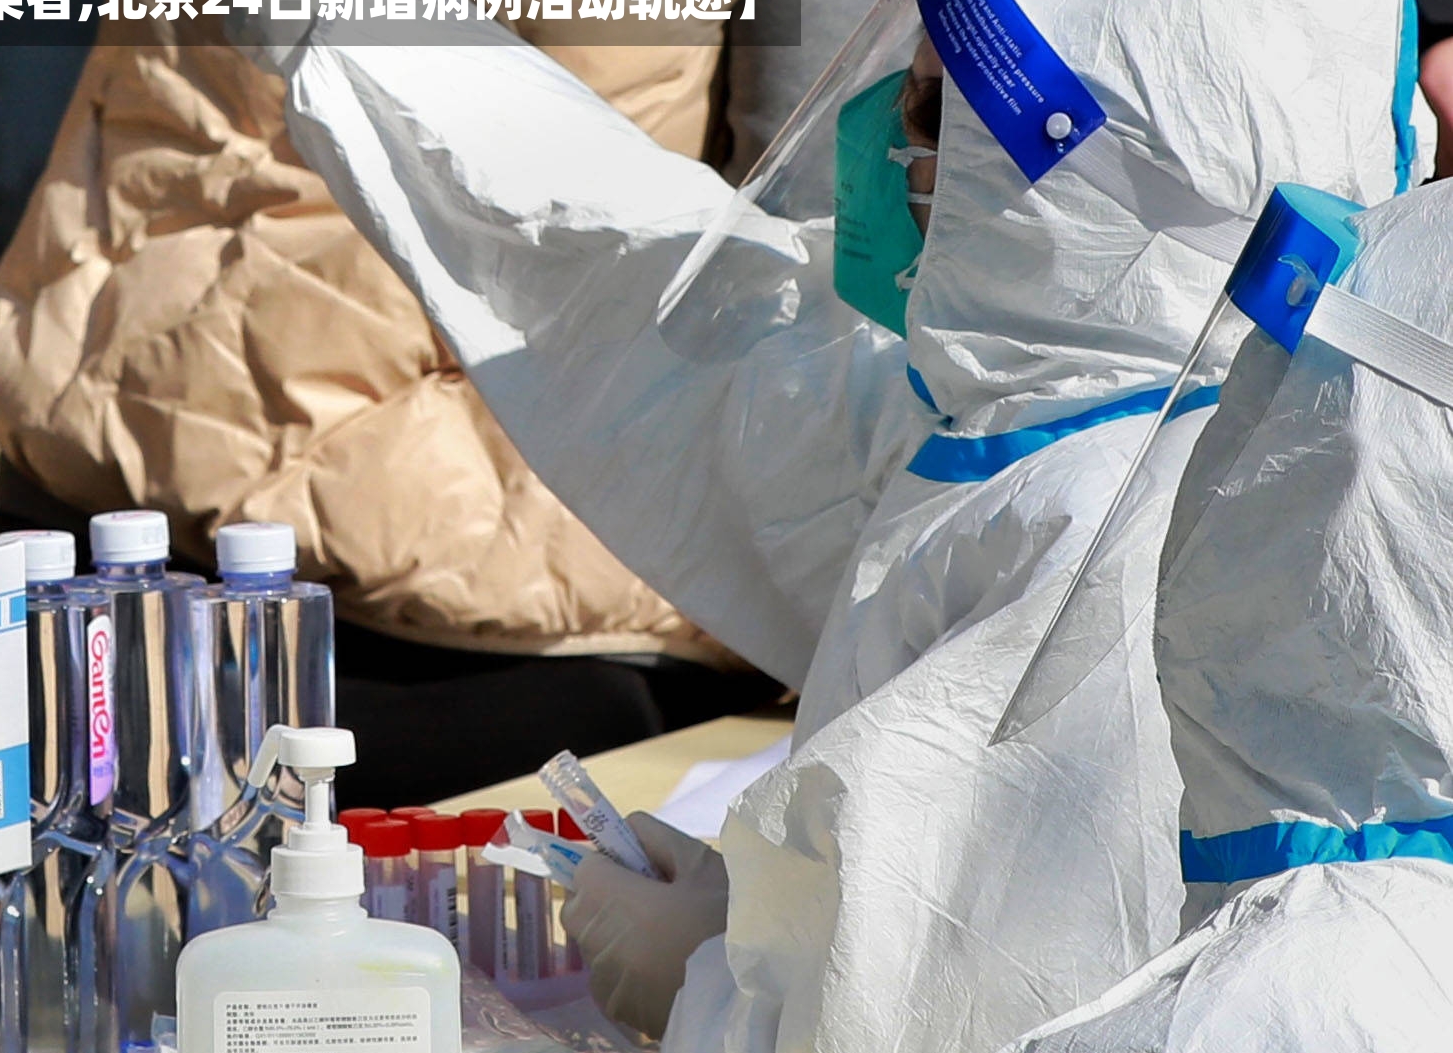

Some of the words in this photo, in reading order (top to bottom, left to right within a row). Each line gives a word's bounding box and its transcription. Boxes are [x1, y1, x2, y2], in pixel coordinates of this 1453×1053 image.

[992, 18, 1023, 58] Anti-static
[977, 59, 1009, 99] protective
[1006, 97, 1022, 116] film
[992, 36, 1017, 70] relieves
[1014, 67, 1044, 103] pressure
[997, 67, 1016, 88] clear
